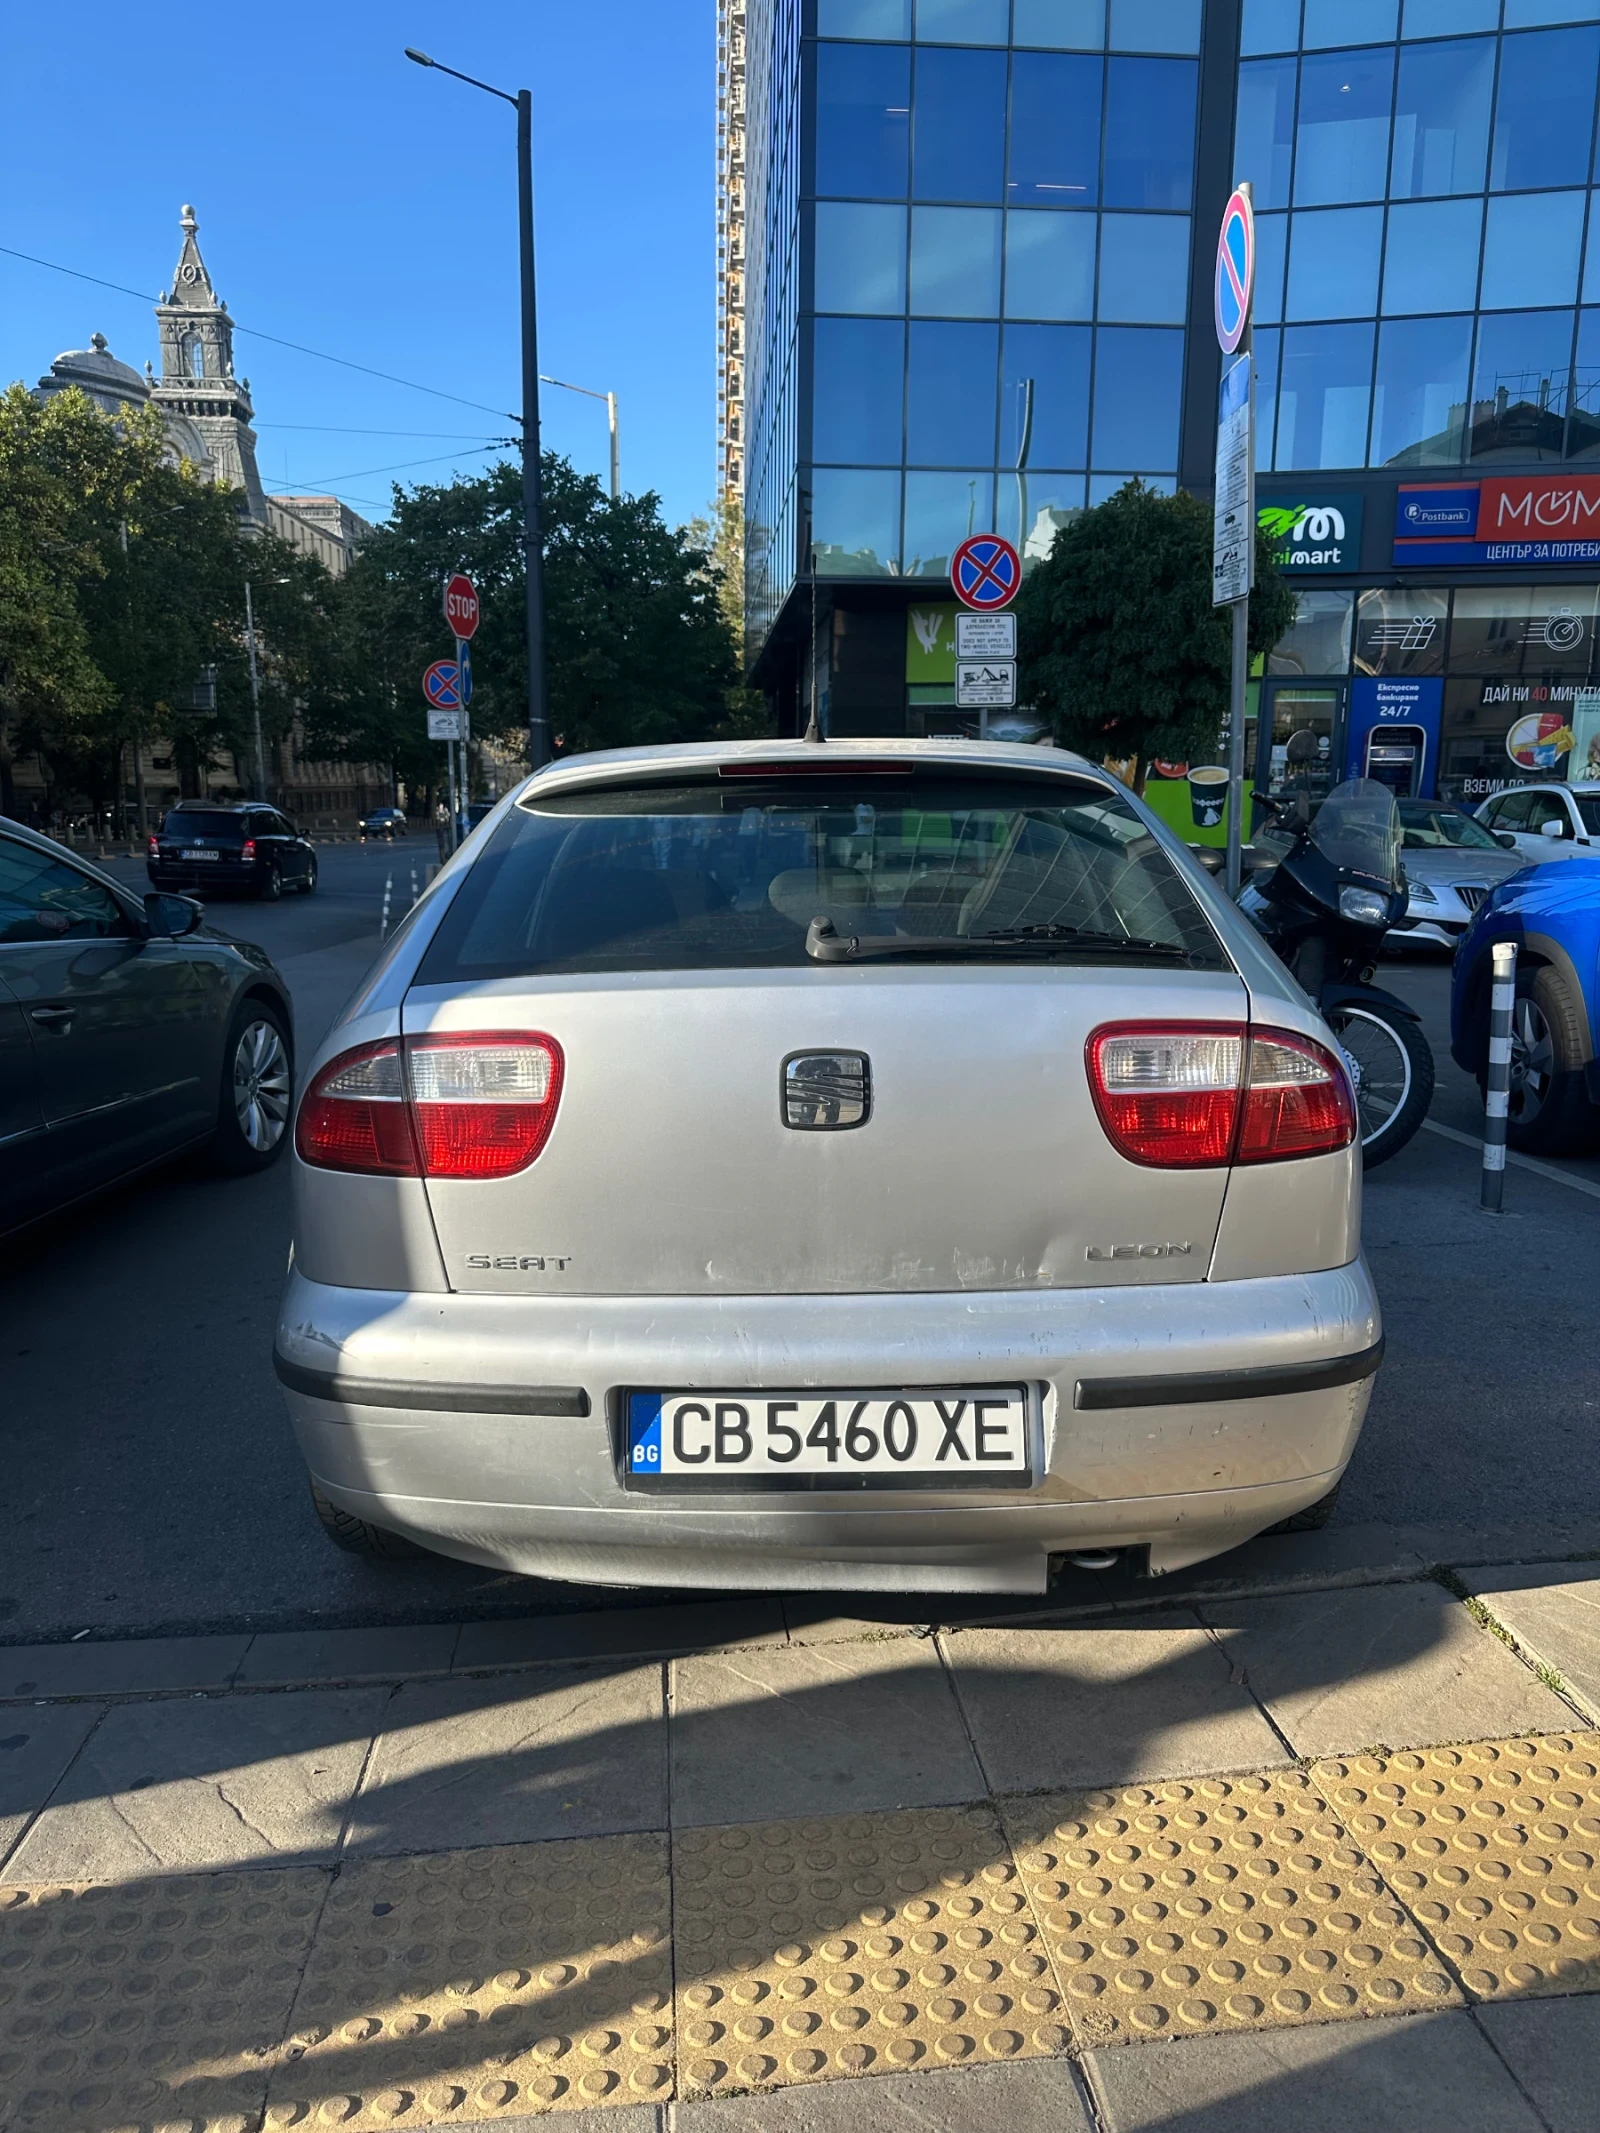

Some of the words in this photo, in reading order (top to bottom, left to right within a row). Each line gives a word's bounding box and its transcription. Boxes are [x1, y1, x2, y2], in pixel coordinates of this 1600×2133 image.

[1421, 511, 1465, 521] Postbank
[1486, 544, 1532, 560] ЦЕНТЪР
[1533, 544, 1549, 558] ЗА
[448, 594, 477, 621] STOP
[1377, 683, 1420, 692] Експресно
[1482, 684, 1510, 703] ДАЙ
[1512, 686, 1529, 702] НИ
[1531, 686, 1548, 701] 40
[1550, 686, 1600, 702] МИНУТИ
[1376, 693, 1419, 702] банкиране
[1379, 705, 1411, 717] 24/7
[1463, 778, 1505, 794] ВЗЕМИ
[1084, 1241, 1193, 1262] LEON
[465, 1254, 573, 1272] SEAT
[633, 1443, 659, 1464] BG
[672, 1402, 754, 1464] CB
[766, 1400, 918, 1463] 5460
[935, 1400, 1015, 1462] XE
